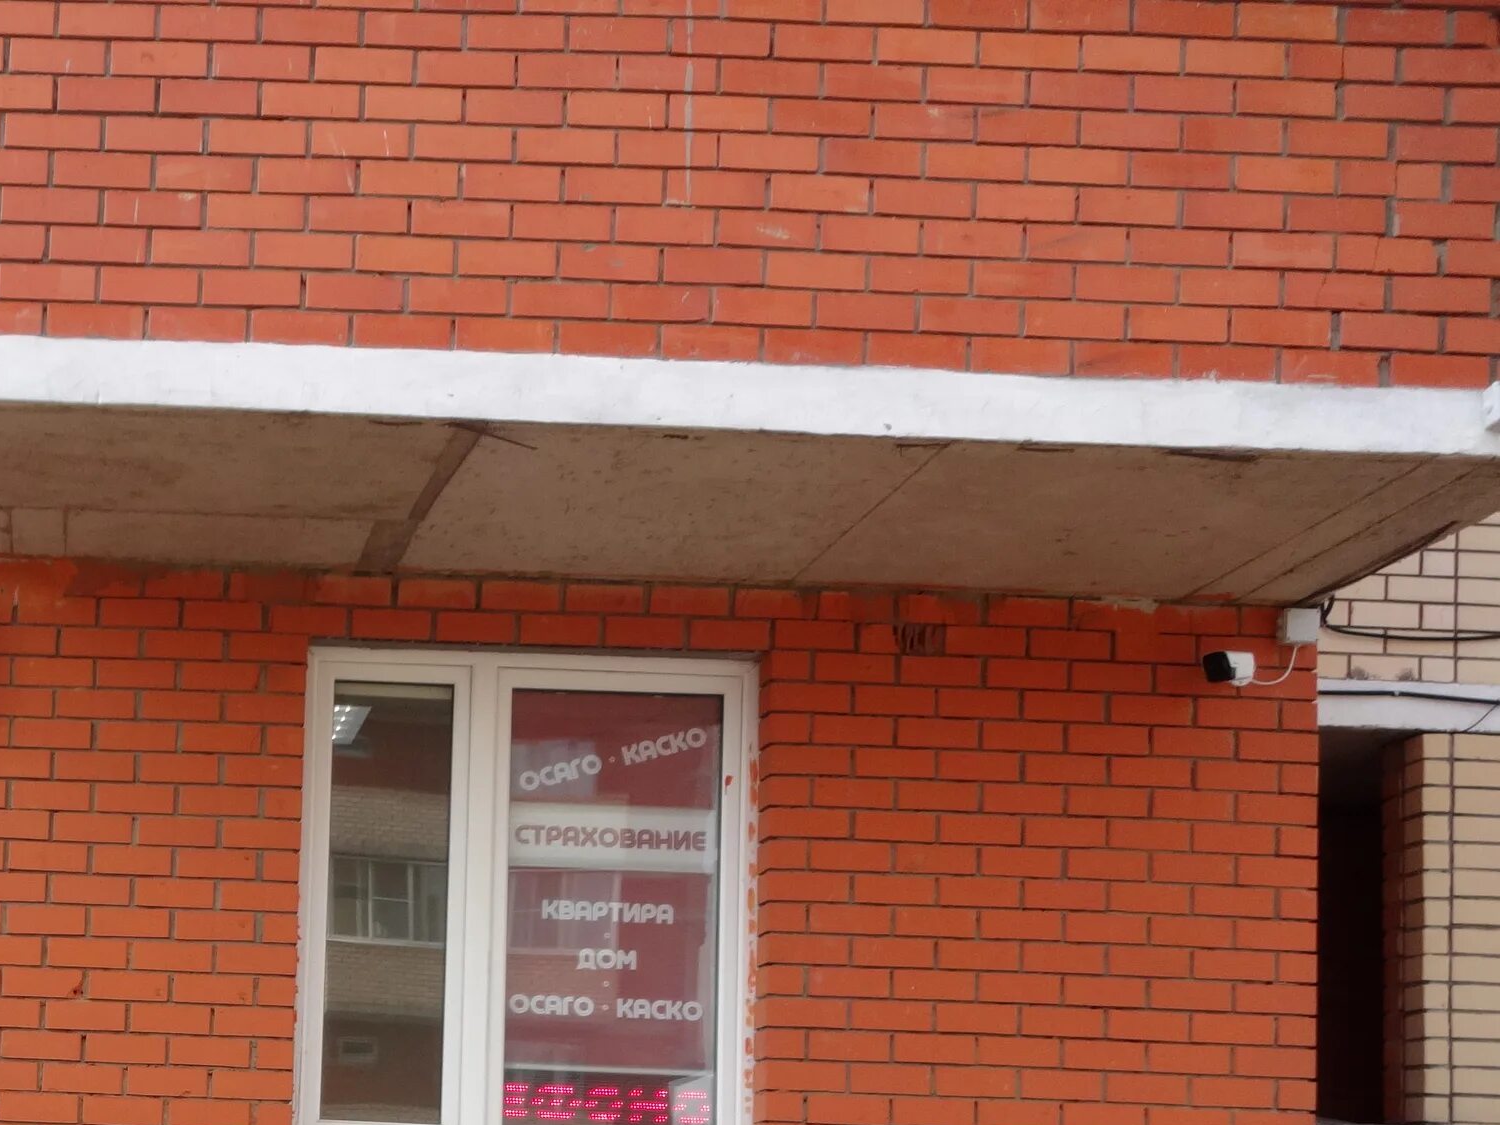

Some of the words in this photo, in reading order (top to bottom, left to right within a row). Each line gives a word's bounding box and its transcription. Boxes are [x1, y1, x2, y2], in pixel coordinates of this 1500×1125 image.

[519, 753, 603, 792] ОСАГО
[621, 727, 708, 766] КАСКО
[514, 824, 707, 852] СТРАХОВАНИЕ
[541, 899, 675, 925] КВАРТИРА
[576, 948, 637, 971] ДОМ
[509, 994, 594, 1017] ОСАГО
[616, 998, 704, 1022] КАСКО
